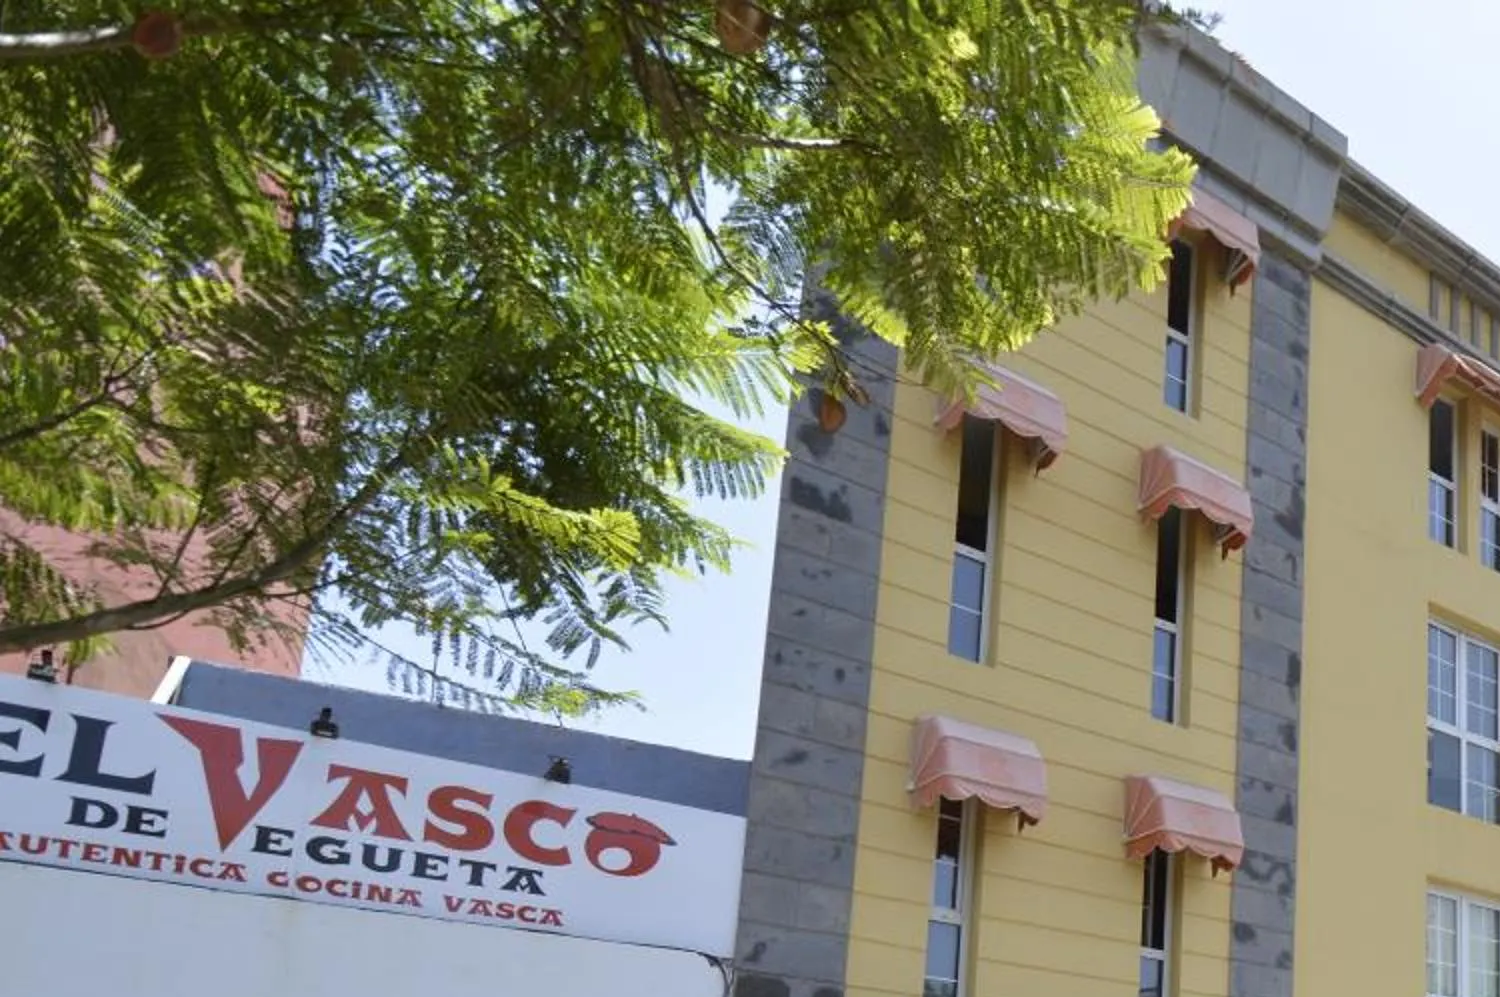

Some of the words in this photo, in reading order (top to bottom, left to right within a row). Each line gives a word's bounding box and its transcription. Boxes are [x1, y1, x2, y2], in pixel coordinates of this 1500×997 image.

[0, 702, 157, 796] EL
[154, 712, 678, 878] VASCO
[65, 796, 169, 838] DE
[266, 871, 424, 908] COCINA
[443, 894, 565, 926] VASCA
